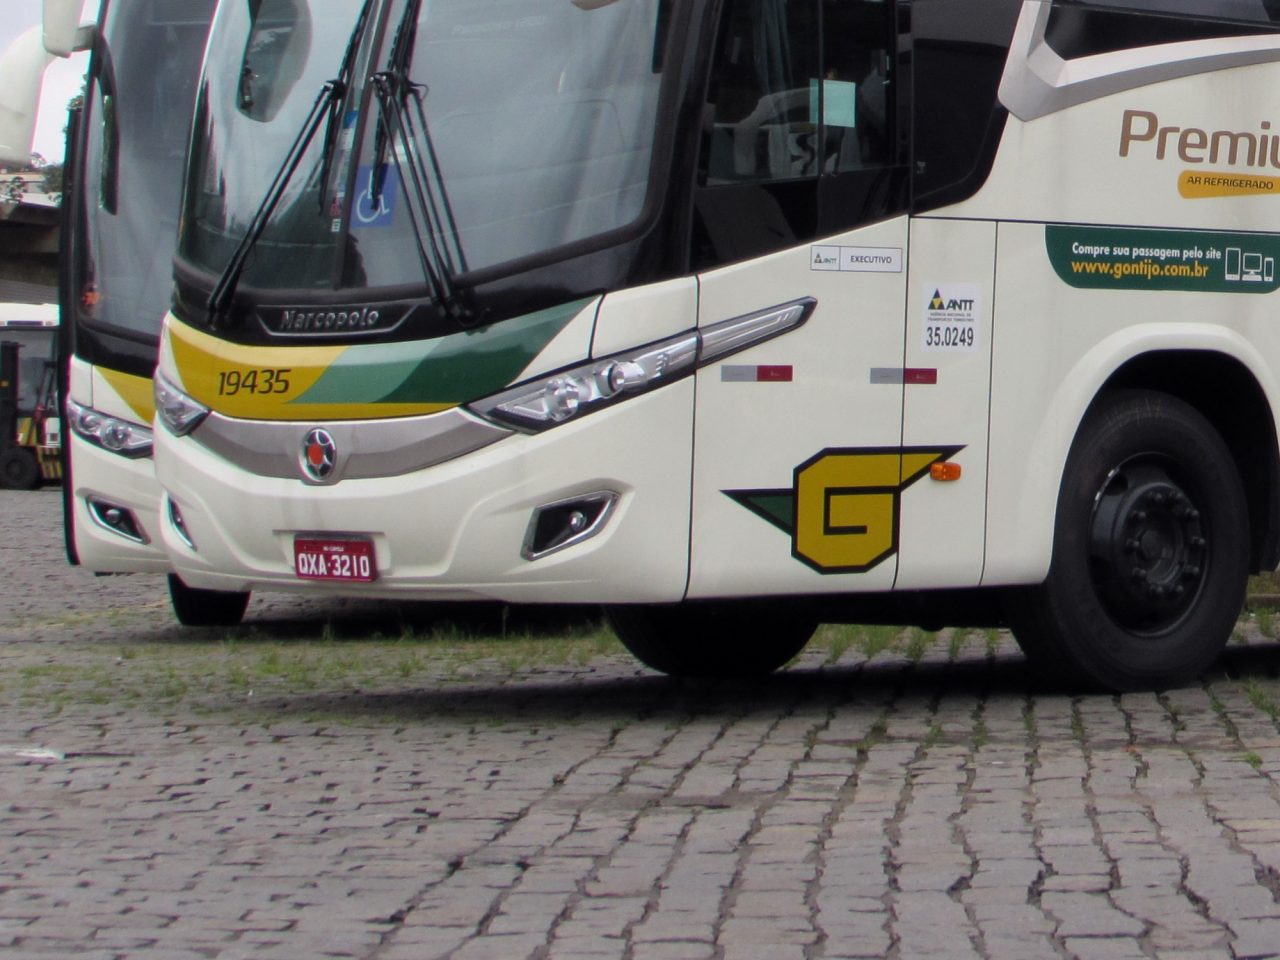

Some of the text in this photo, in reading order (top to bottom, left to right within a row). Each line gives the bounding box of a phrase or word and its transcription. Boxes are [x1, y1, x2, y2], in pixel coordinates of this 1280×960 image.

[1187, 176, 1274, 190] AR REFRIGERADO
[850, 255, 892, 264] EXECUTIVO
[1072, 242, 1221, 261] Compre sua passagem pelo site
[1071, 260, 1209, 279] www.gontijo.com.br
[946, 299, 975, 311] ANTT
[281, 308, 379, 329] Marcopolo
[926, 326, 974, 347] 35.0249
[218, 369, 291, 396] 19435
